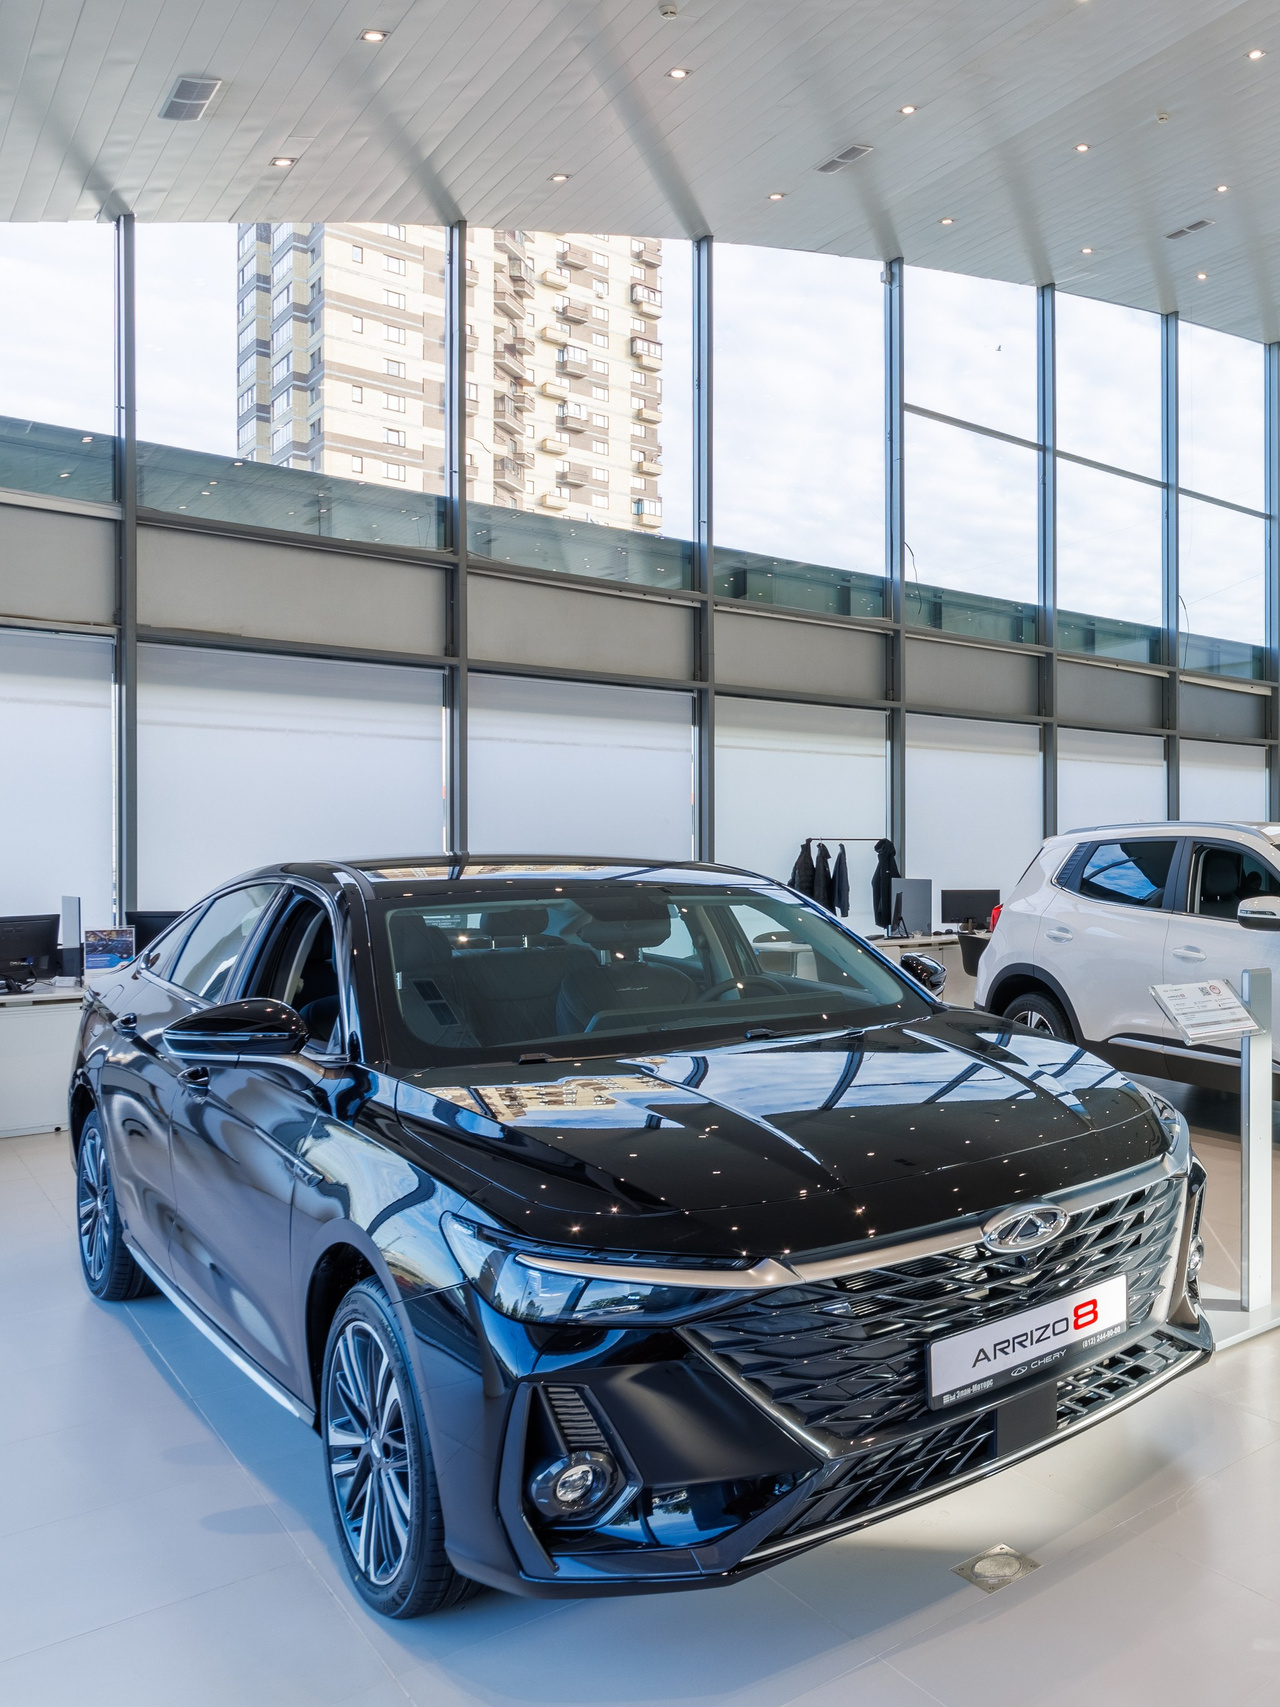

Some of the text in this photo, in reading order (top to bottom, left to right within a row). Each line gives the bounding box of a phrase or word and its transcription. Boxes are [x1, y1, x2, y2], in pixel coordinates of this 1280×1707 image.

[972, 1298, 1098, 1368] ARRIZO 8
[1082, 1337, 1096, 1349] (812)
[1030, 1349, 1067, 1369] CHERY
